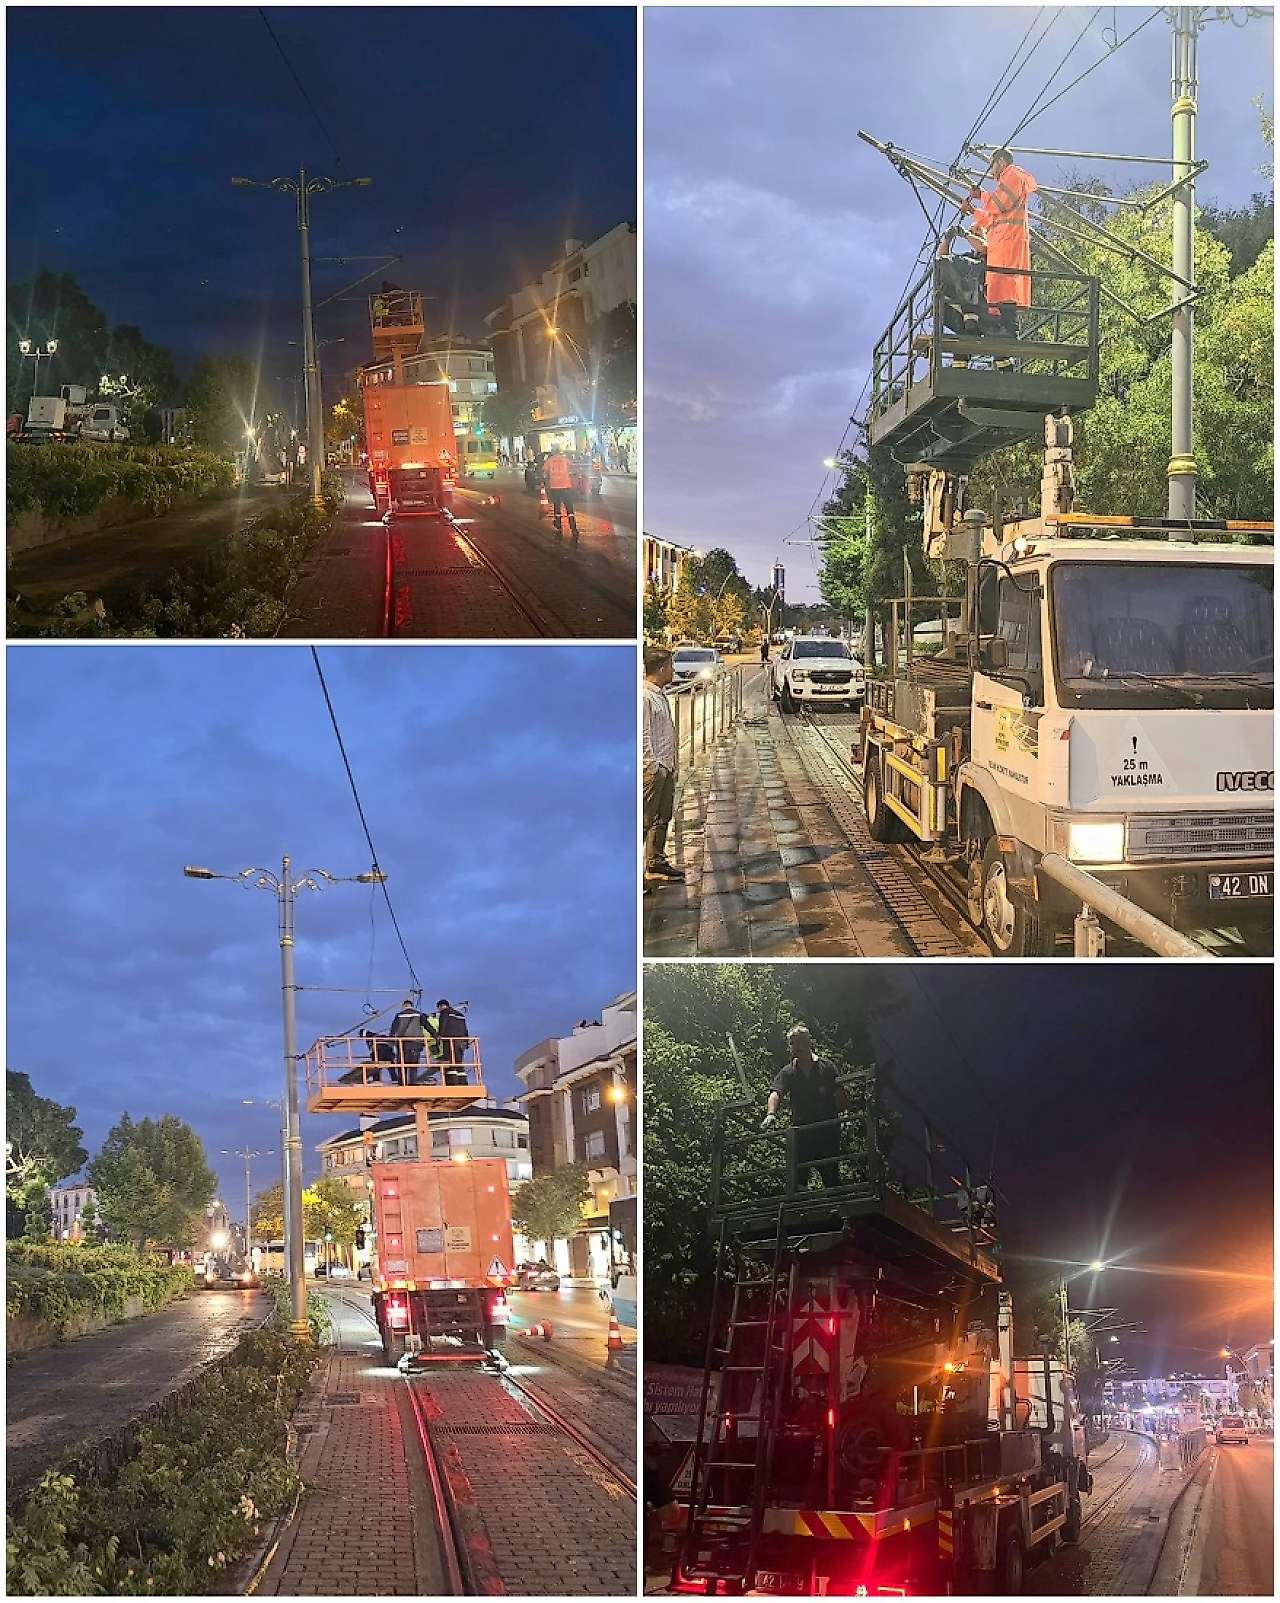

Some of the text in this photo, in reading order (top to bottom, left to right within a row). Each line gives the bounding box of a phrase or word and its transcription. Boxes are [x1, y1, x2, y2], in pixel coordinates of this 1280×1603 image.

[1123, 758, 1148, 771] 25 m
[1110, 773, 1163, 787] YAKLAŞMA
[1222, 875, 1268, 896] 42 DN
[647, 1382, 684, 1397] Sistem
